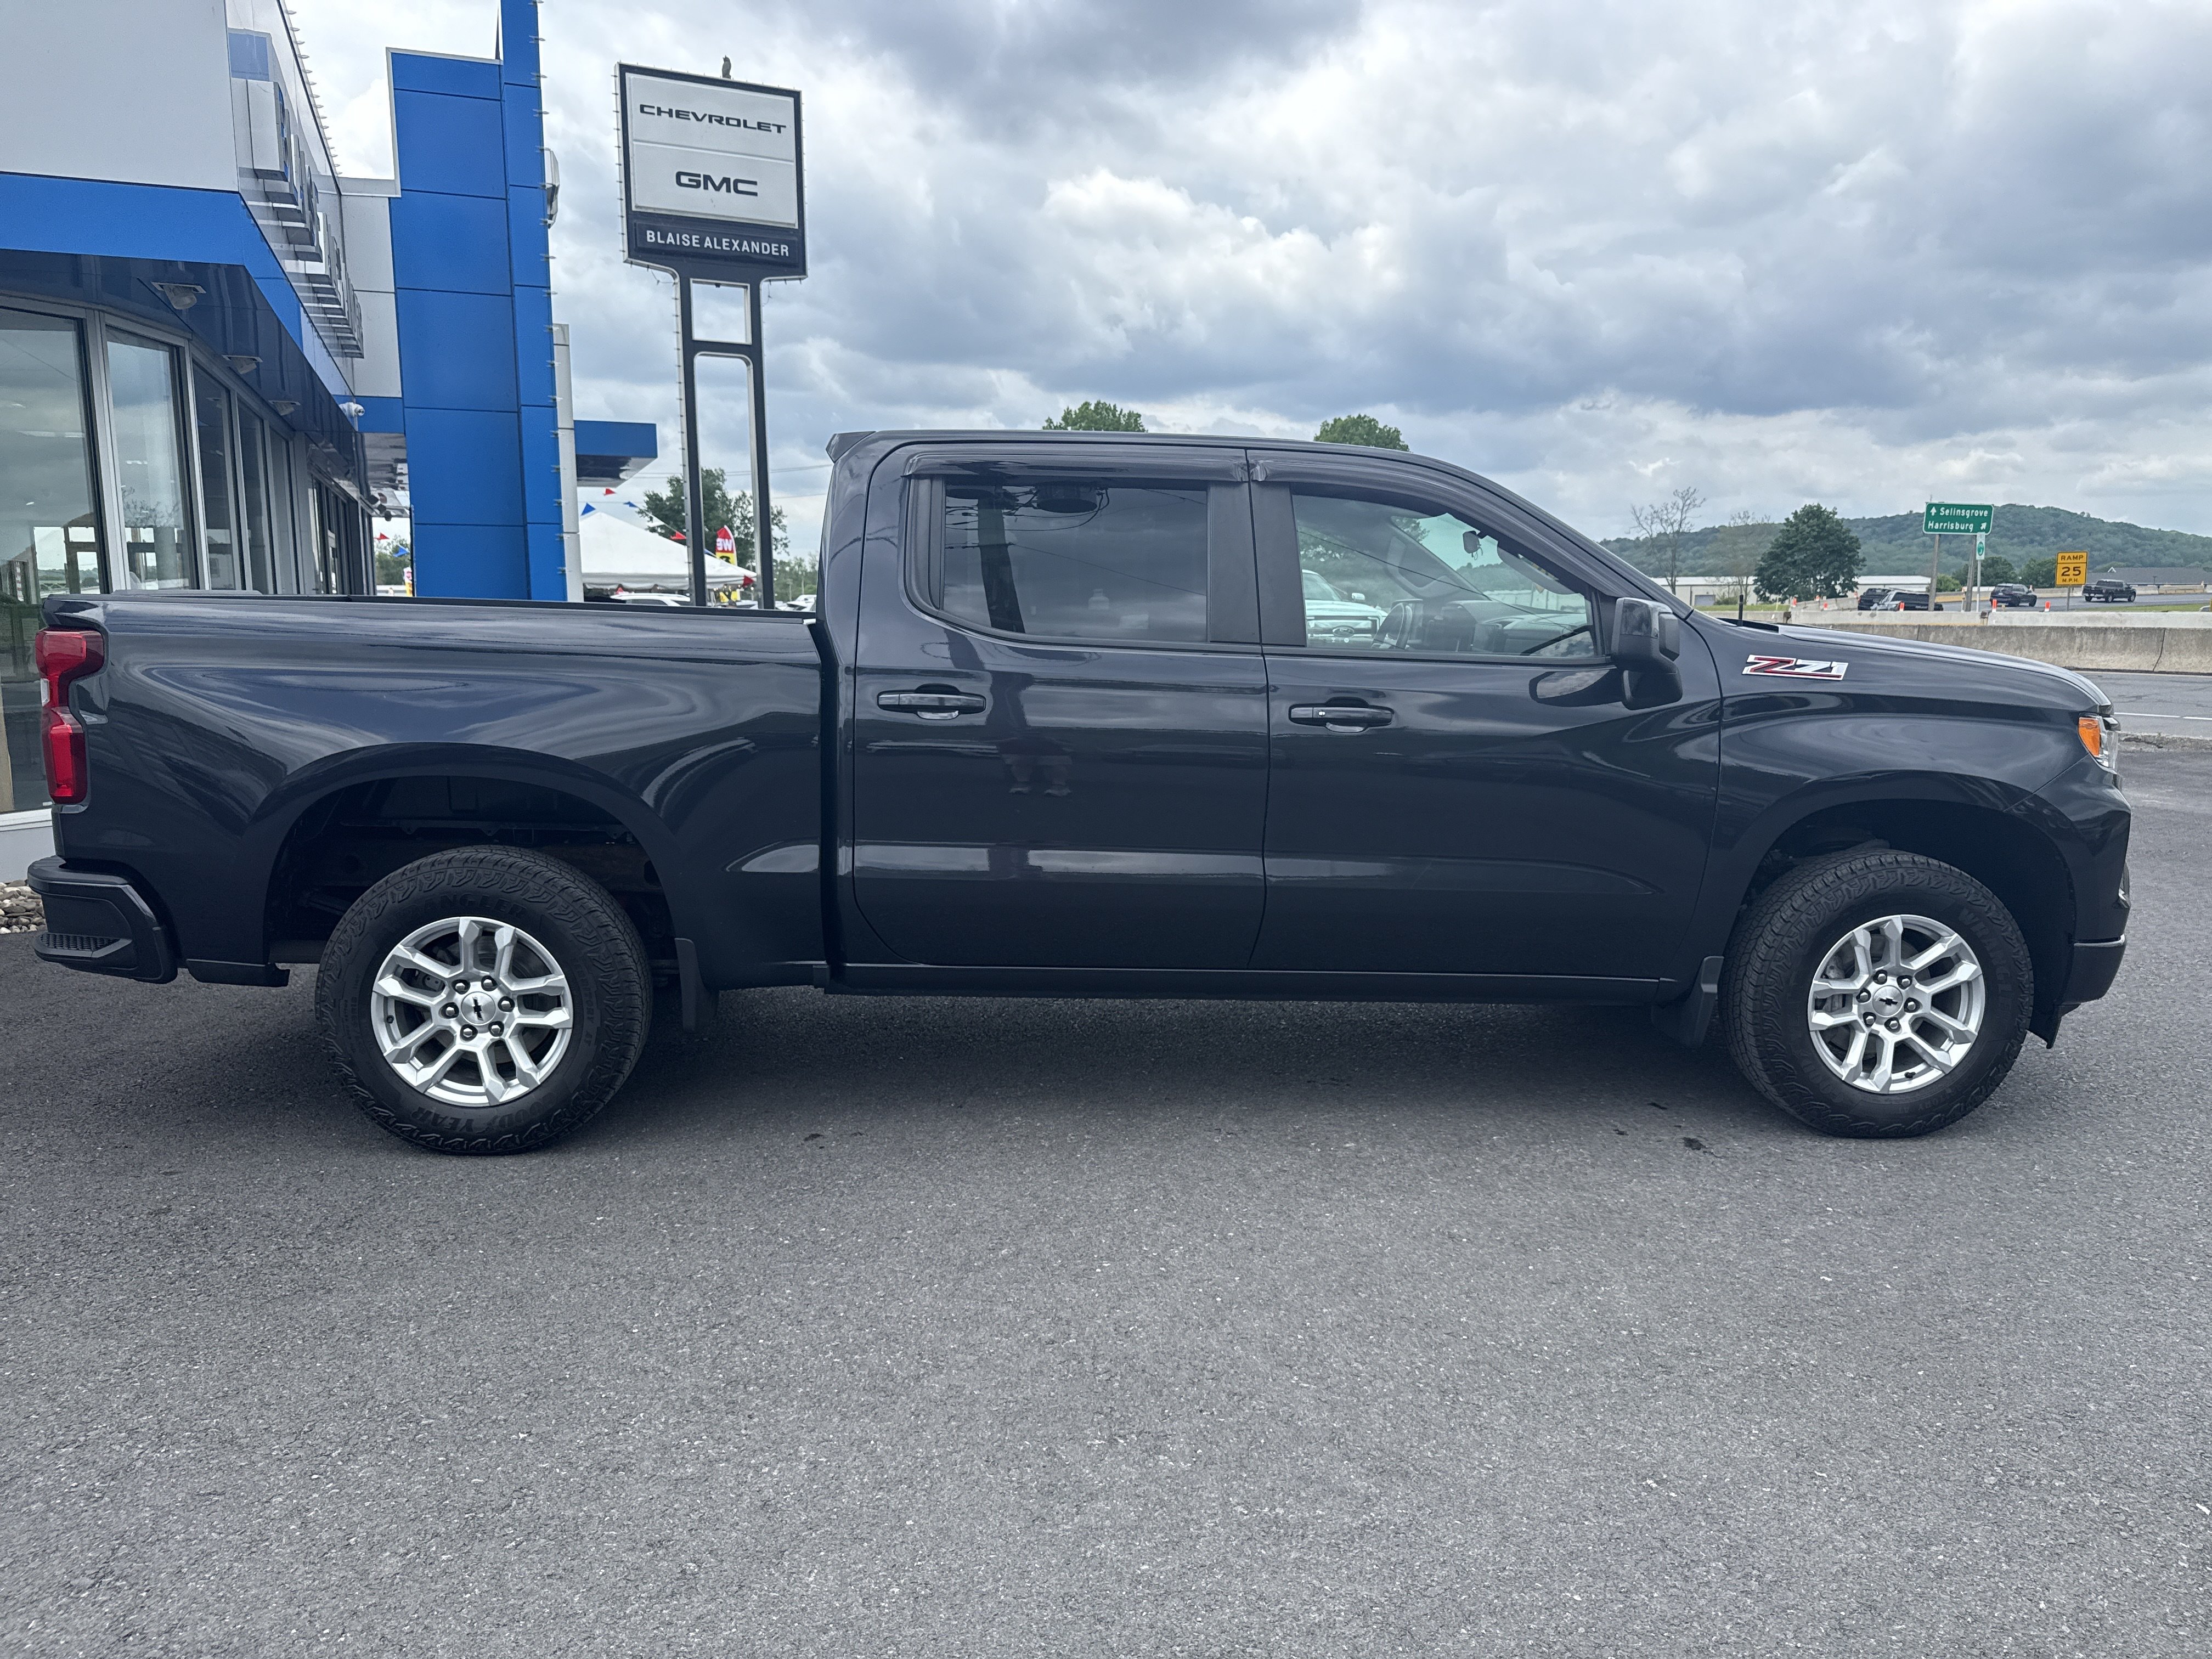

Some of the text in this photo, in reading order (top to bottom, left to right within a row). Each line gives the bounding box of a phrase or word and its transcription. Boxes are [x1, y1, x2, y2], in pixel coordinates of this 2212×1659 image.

[640, 104, 786, 134] CHEVROLET
[675, 171, 758, 196] GMC
[646, 229, 789, 257] BLAISE ALEXANDER
[1939, 507, 1988, 518] Selinsgrove
[1927, 520, 1974, 533] Harrisburg
[2061, 566, 2081, 577] 25
[1742, 654, 1849, 681] Z71
